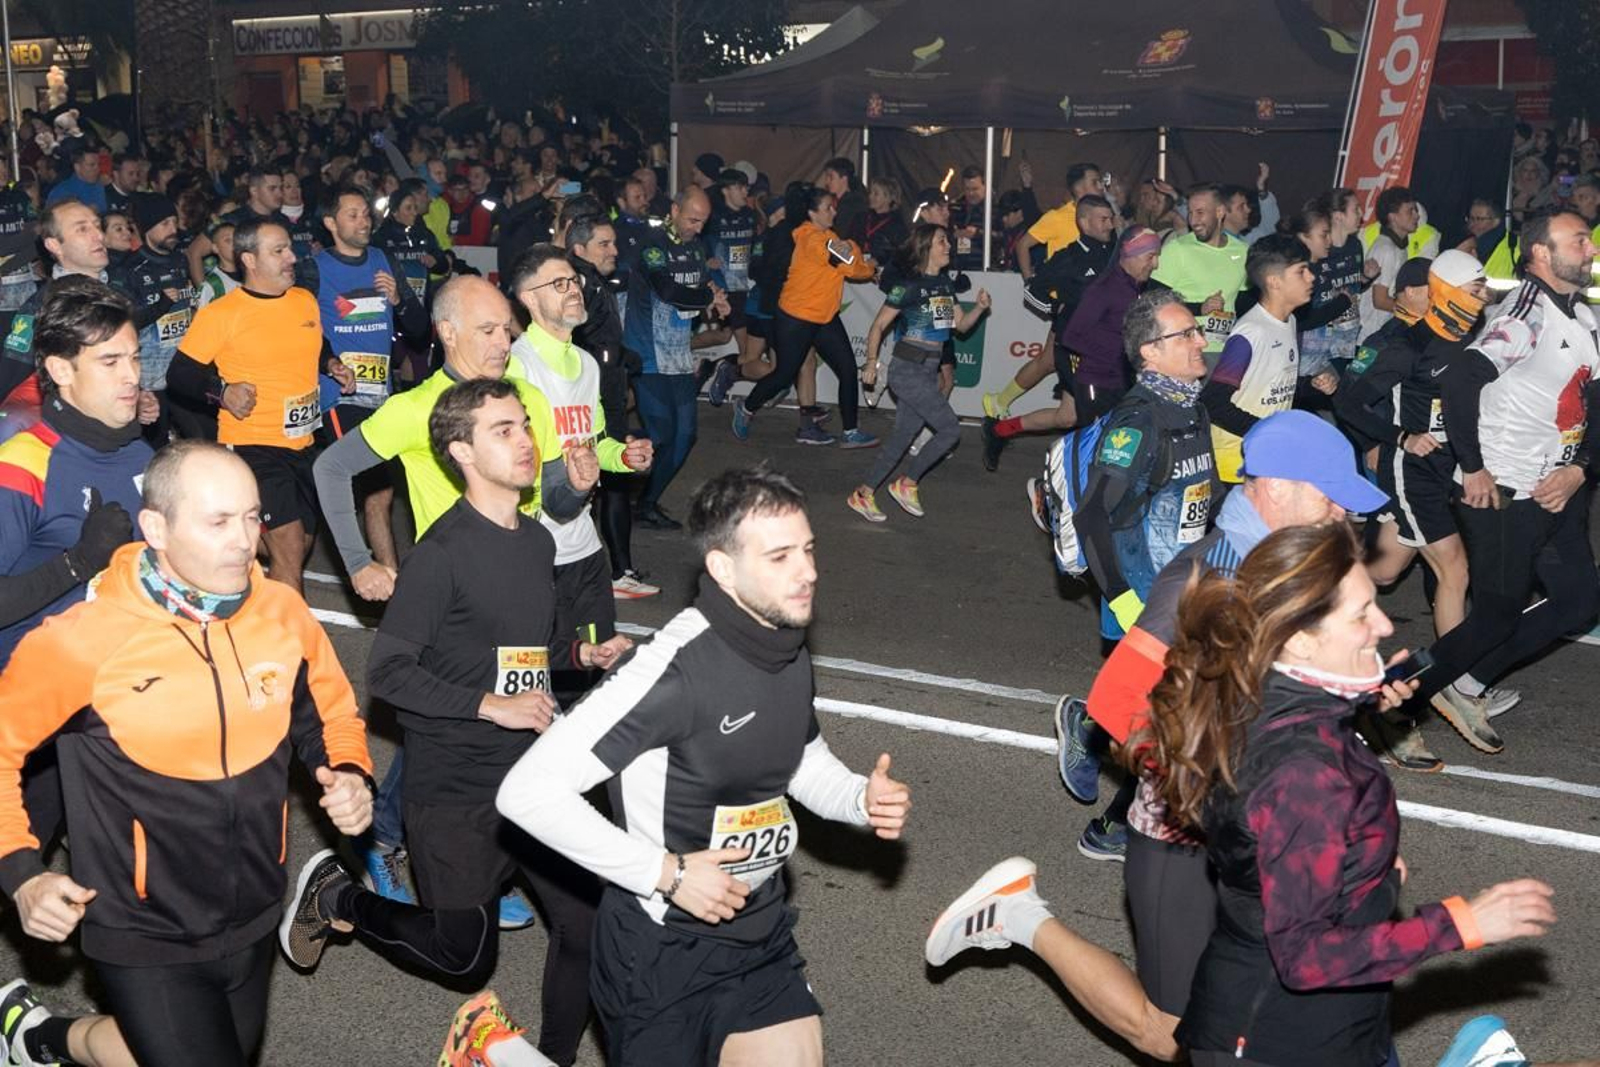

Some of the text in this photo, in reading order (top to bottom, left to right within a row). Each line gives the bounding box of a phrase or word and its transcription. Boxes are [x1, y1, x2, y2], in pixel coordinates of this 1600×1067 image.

[0, 43, 42, 64] NEO
[147, 292, 161, 305] SA
[921, 303, 934, 313] SA
[334, 322, 388, 333] FREE PALESTINE
[955, 353, 977, 365] RAL
[356, 364, 386, 380] 219
[553, 404, 592, 436] NETS
[503, 670, 550, 696] 898
